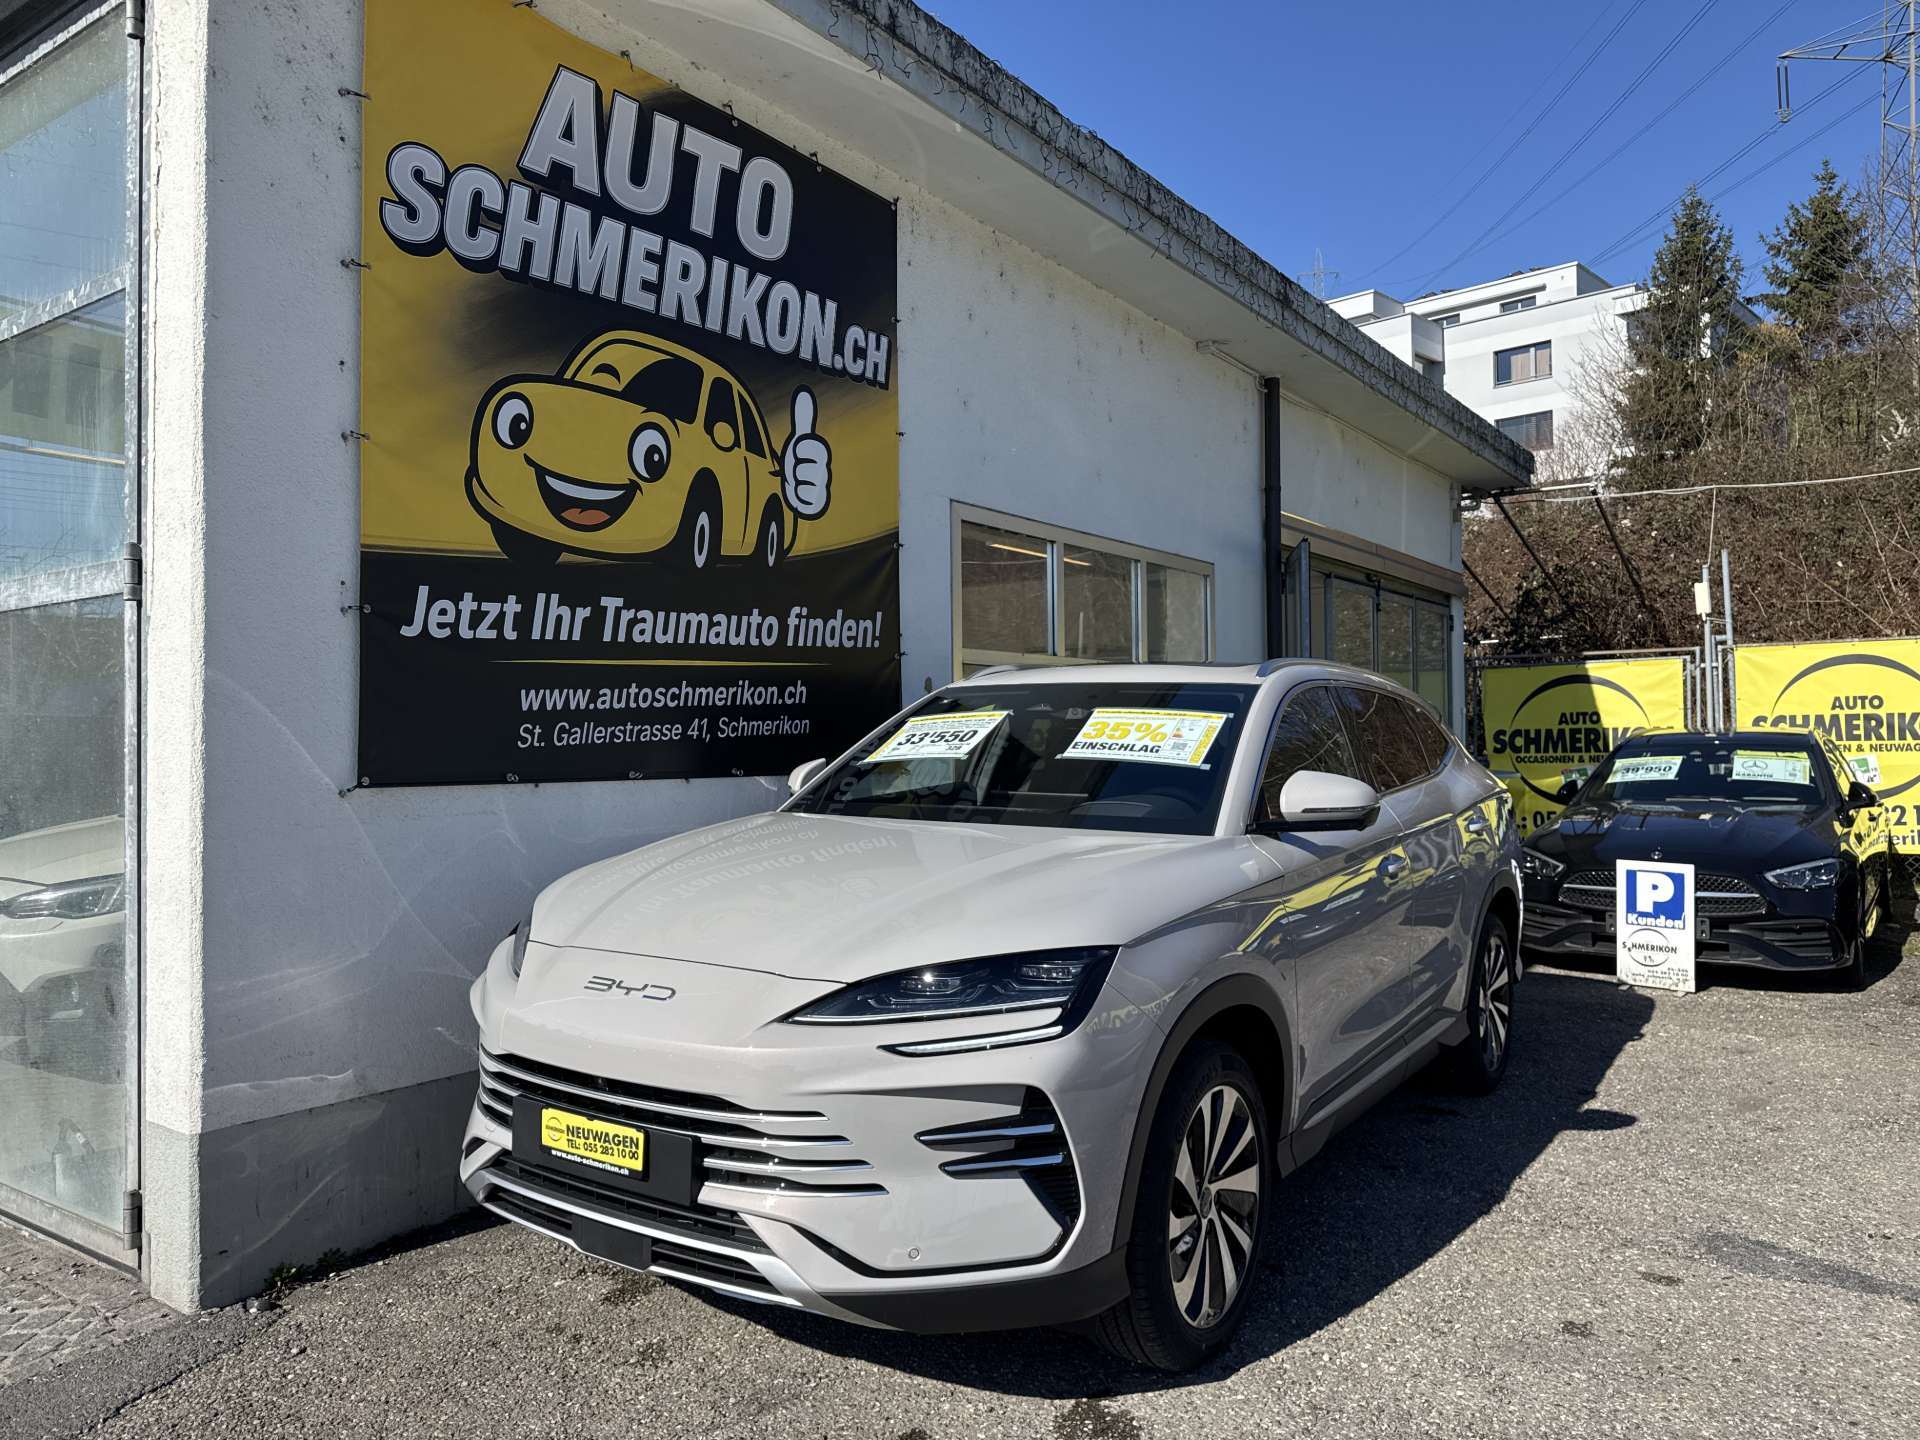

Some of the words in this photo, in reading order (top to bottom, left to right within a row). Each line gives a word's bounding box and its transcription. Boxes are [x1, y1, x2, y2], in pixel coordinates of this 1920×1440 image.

[518, 64, 794, 261] AUTO
[381, 141, 891, 388] SCHMERIKON.CH
[400, 585, 520, 639] Jetzt
[531, 592, 591, 641] Ihr
[600, 596, 778, 646] Traumauto
[785, 608, 883, 648] finden!
[520, 680, 807, 712] www.autoschmerikon.ch
[1831, 695, 1884, 710] AUTO
[1558, 712, 1601, 725] AUTO
[1752, 712, 1920, 742] MERIK
[517, 724, 546, 749] St.
[552, 719, 682, 746] Gallerstrasse
[687, 718, 712, 744] 41,
[716, 716, 810, 741] Schmerikon
[897, 729, 978, 746] 33'550
[1081, 721, 1169, 743] 35%
[1071, 741, 1162, 754] EINSCHLAG
[1856, 744, 1864, 752] &
[1515, 755, 1575, 764] OCCASIONEN
[1578, 755, 1585, 763] &
[1636, 871, 1675, 913] P
[1627, 912, 1684, 928] Kunden
[584, 975, 676, 1000] BYD
[566, 1124, 639, 1150] NEUWAGEN
[567, 1139, 580, 1149] TEL:
[583, 1142, 598, 1153] 055
[600, 1145, 614, 1156] 282
[617, 1148, 626, 1158] 10
[628, 1150, 639, 1160] 00
